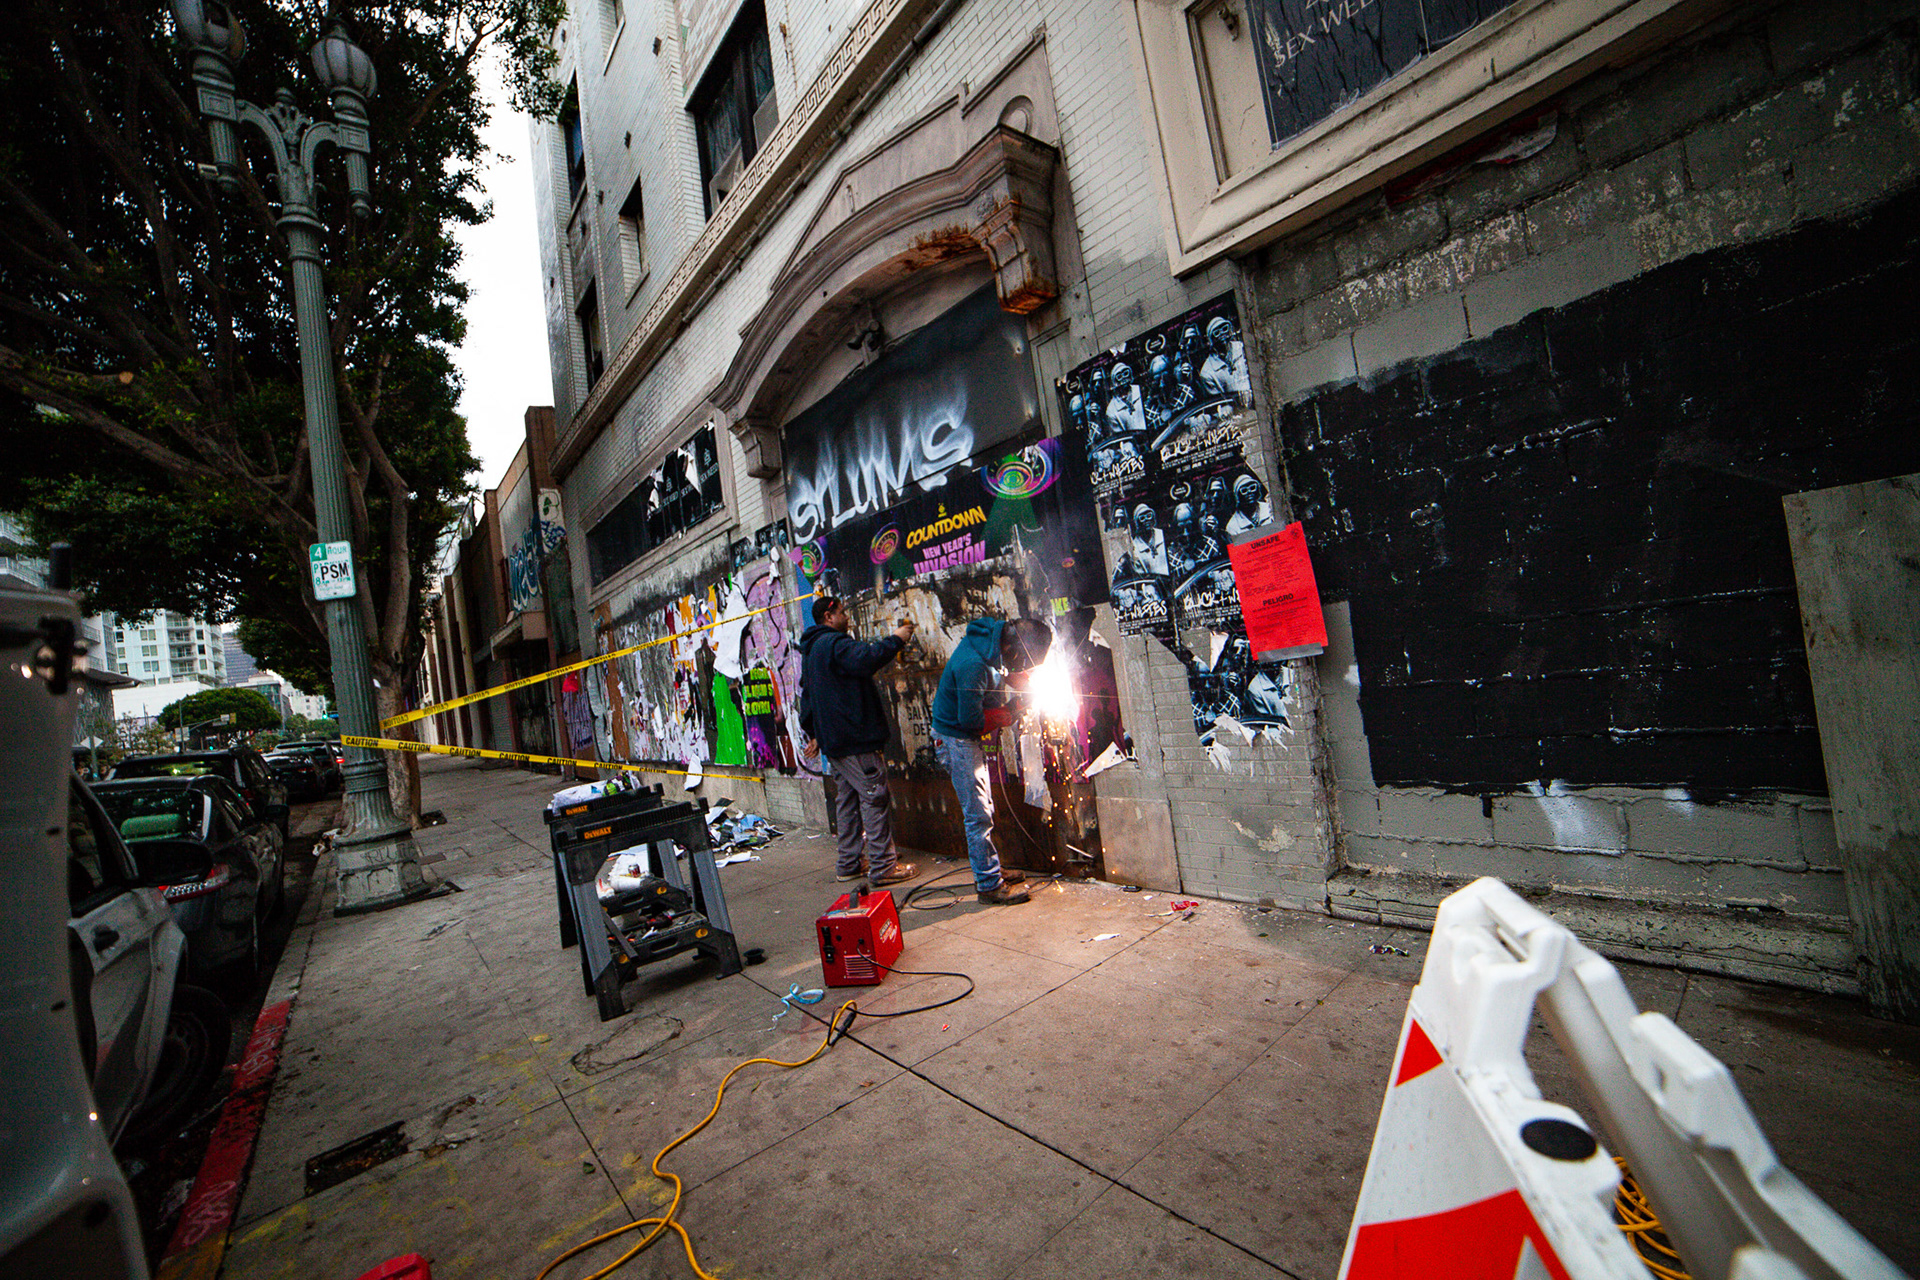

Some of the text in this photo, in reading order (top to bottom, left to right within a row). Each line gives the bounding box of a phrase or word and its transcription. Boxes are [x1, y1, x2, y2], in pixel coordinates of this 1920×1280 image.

[906, 505, 988, 549] COUNTDOWN
[922, 532, 973, 560] NEW YEAR'S
[1250, 534, 1281, 550] UNSAFE
[314, 547, 322, 558] 4
[321, 562, 350, 580] PSM
[1262, 592, 1294, 607] PELIGRO
[345, 736, 379, 748] CAUTION
[397, 741, 432, 752] CAUTION
[449, 747, 482, 757] CAUTION
[499, 752, 531, 762] CAUTION
[547, 757, 578, 767] CAUTION
[594, 762, 623, 770] CAUTION
